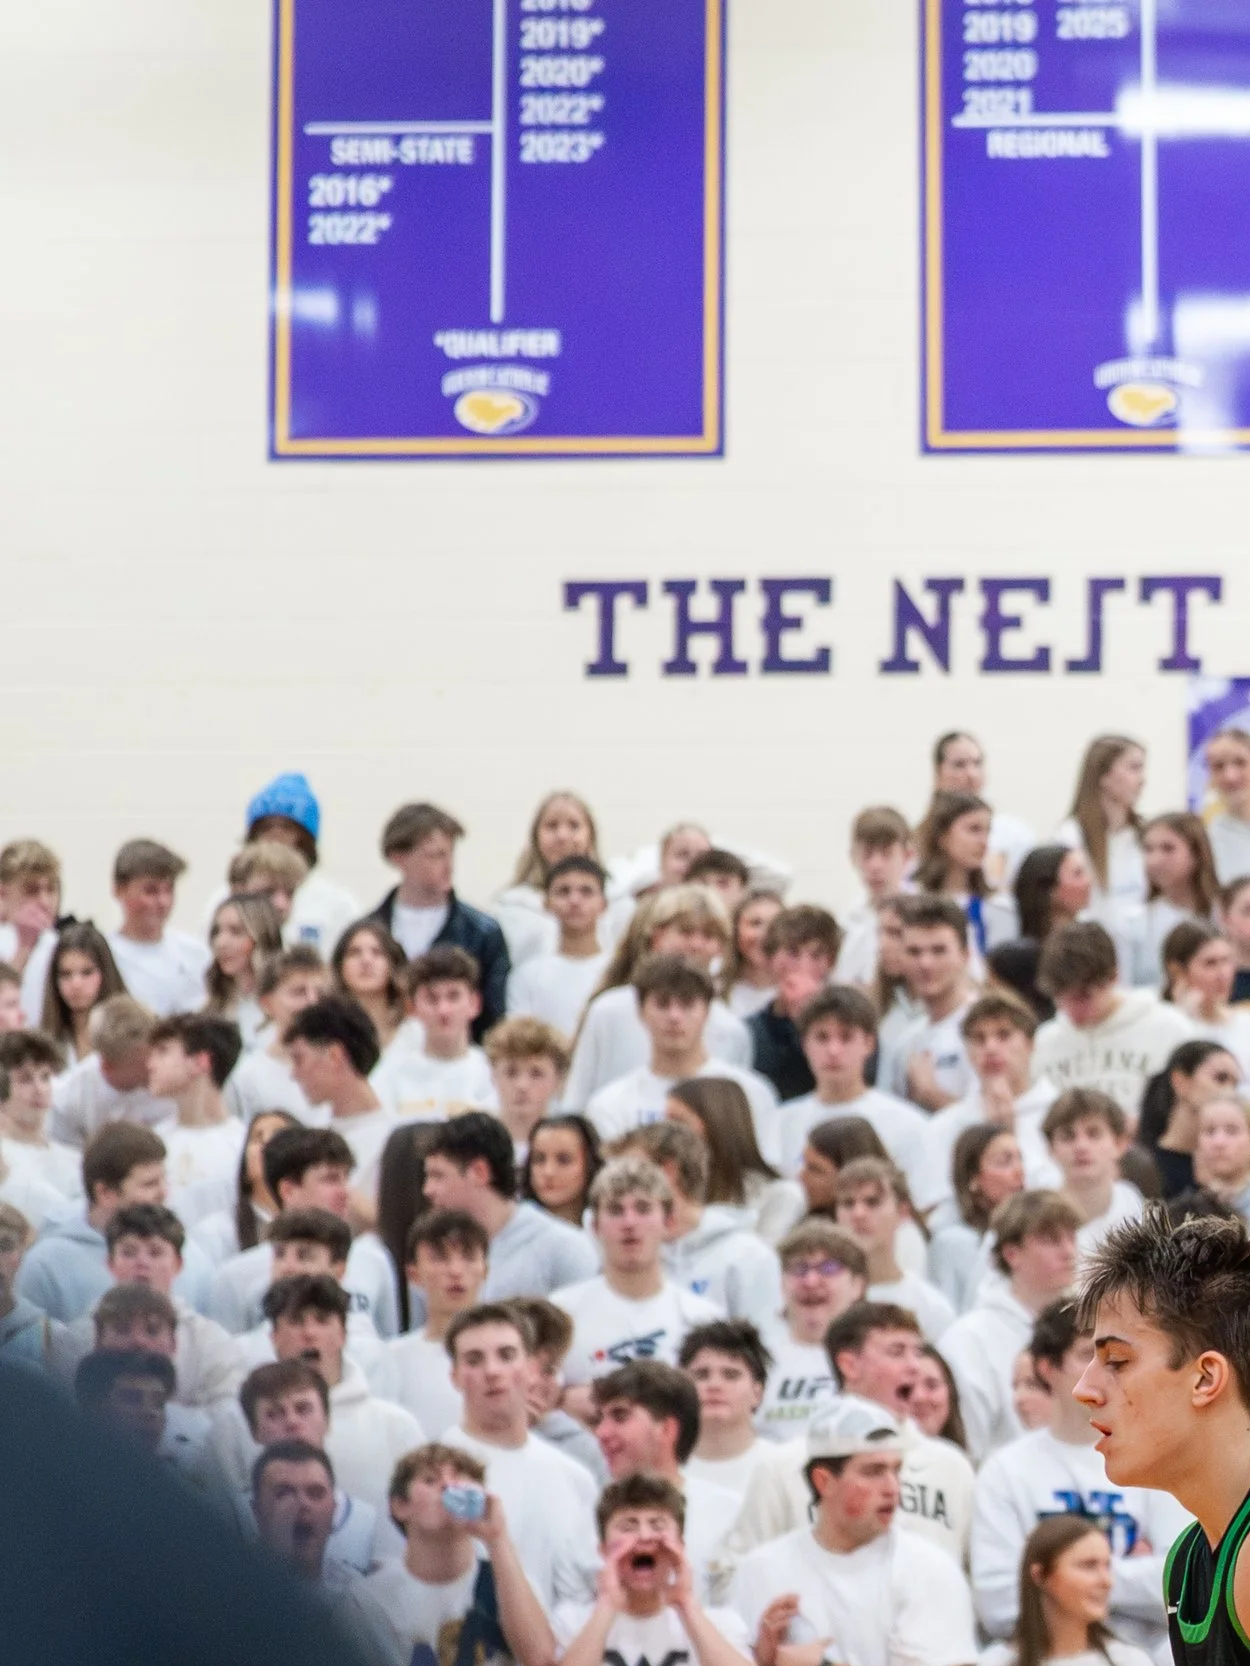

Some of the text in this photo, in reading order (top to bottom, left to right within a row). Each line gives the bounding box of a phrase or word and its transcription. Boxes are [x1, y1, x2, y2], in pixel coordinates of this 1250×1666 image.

[963, 9, 1037, 44] 2019
[1056, 6, 1128, 39] 2025
[963, 48, 1038, 82] 2020
[330, 136, 475, 165] SEMI-STATE
[986, 128, 1110, 158] REGIONAL
[564, 576, 1225, 677] THE NEST
